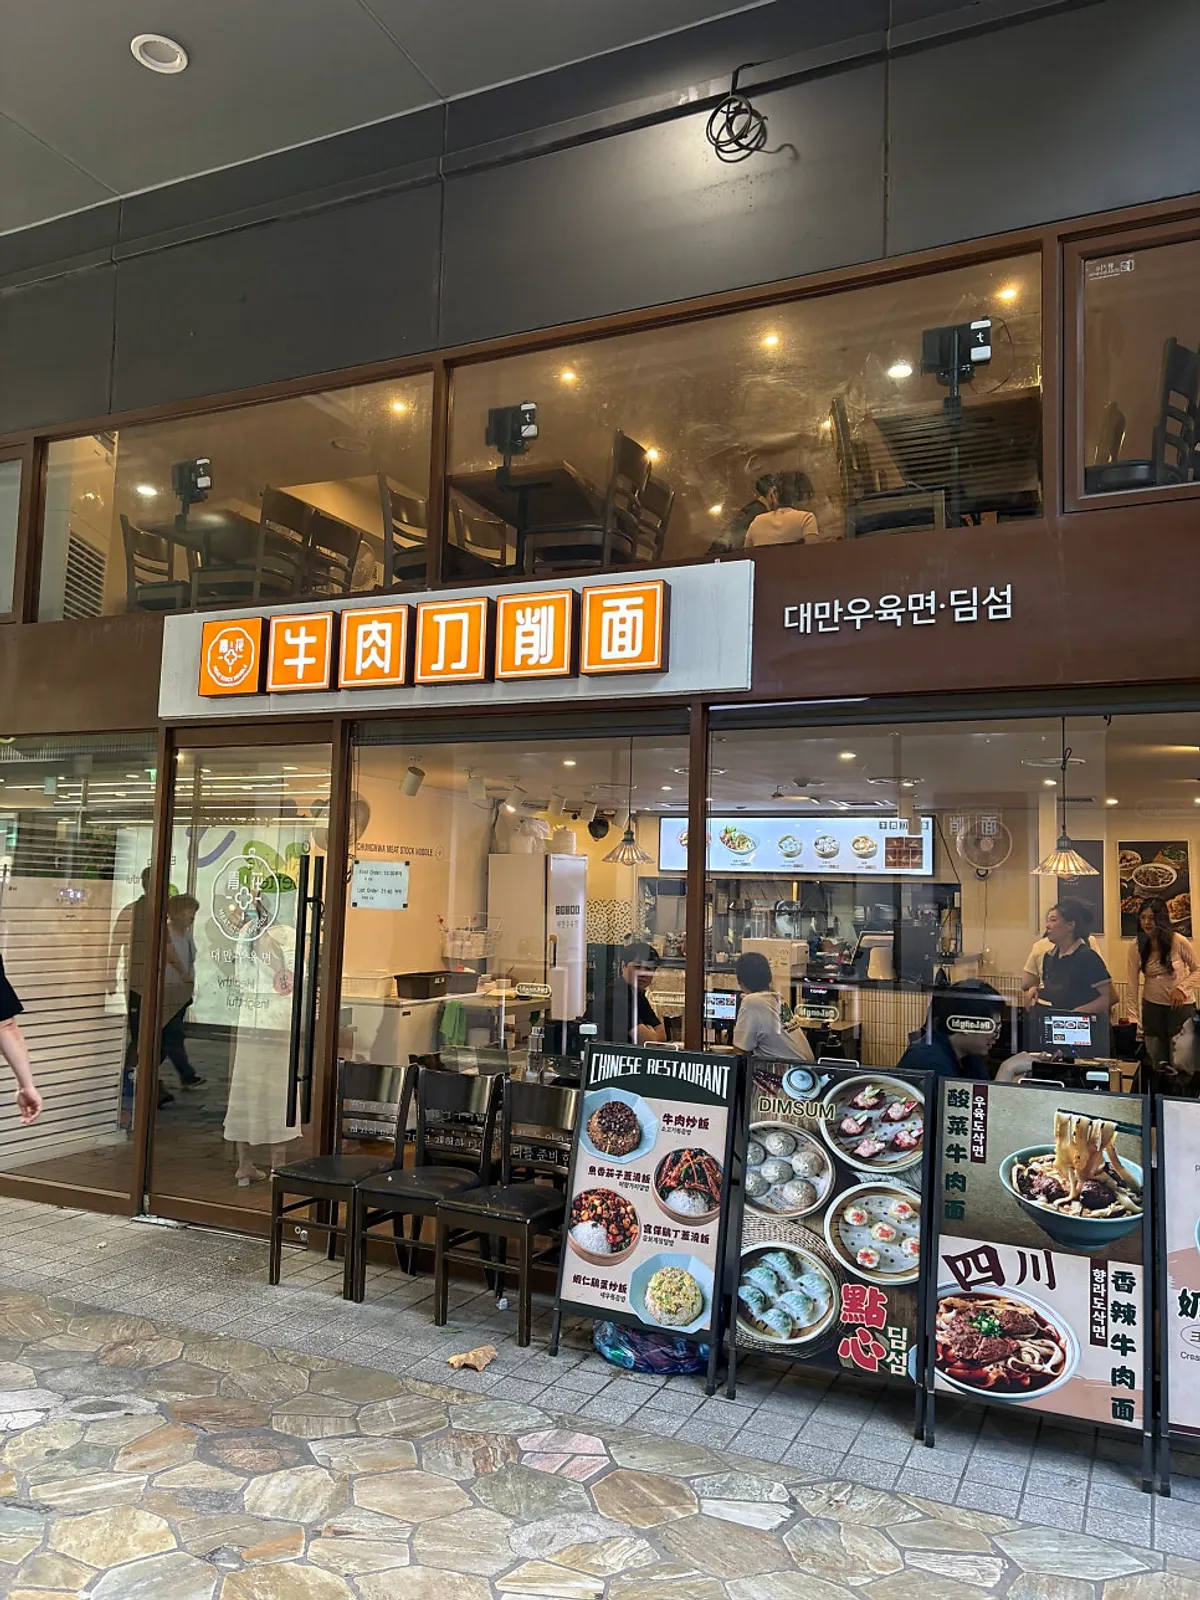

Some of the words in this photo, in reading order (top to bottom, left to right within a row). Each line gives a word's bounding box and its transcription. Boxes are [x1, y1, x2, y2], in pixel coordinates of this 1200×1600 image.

[283, 597, 644, 678] 牛肉刀削面
[589, 1052, 642, 1085] CHINESE
[646, 1058, 731, 1099] RESTAURANT
[758, 1096, 836, 1120] DIMSUM
[972, 1095, 986, 1158] 우육도삭면
[941, 1244, 1056, 1291] 四川
[838, 1284, 889, 1372] 點心
[1091, 1267, 1107, 1340] 향라도삭면
[885, 1325, 908, 1376] 딤섬
[1110, 1270, 1137, 1423] 香辣牛肉面
